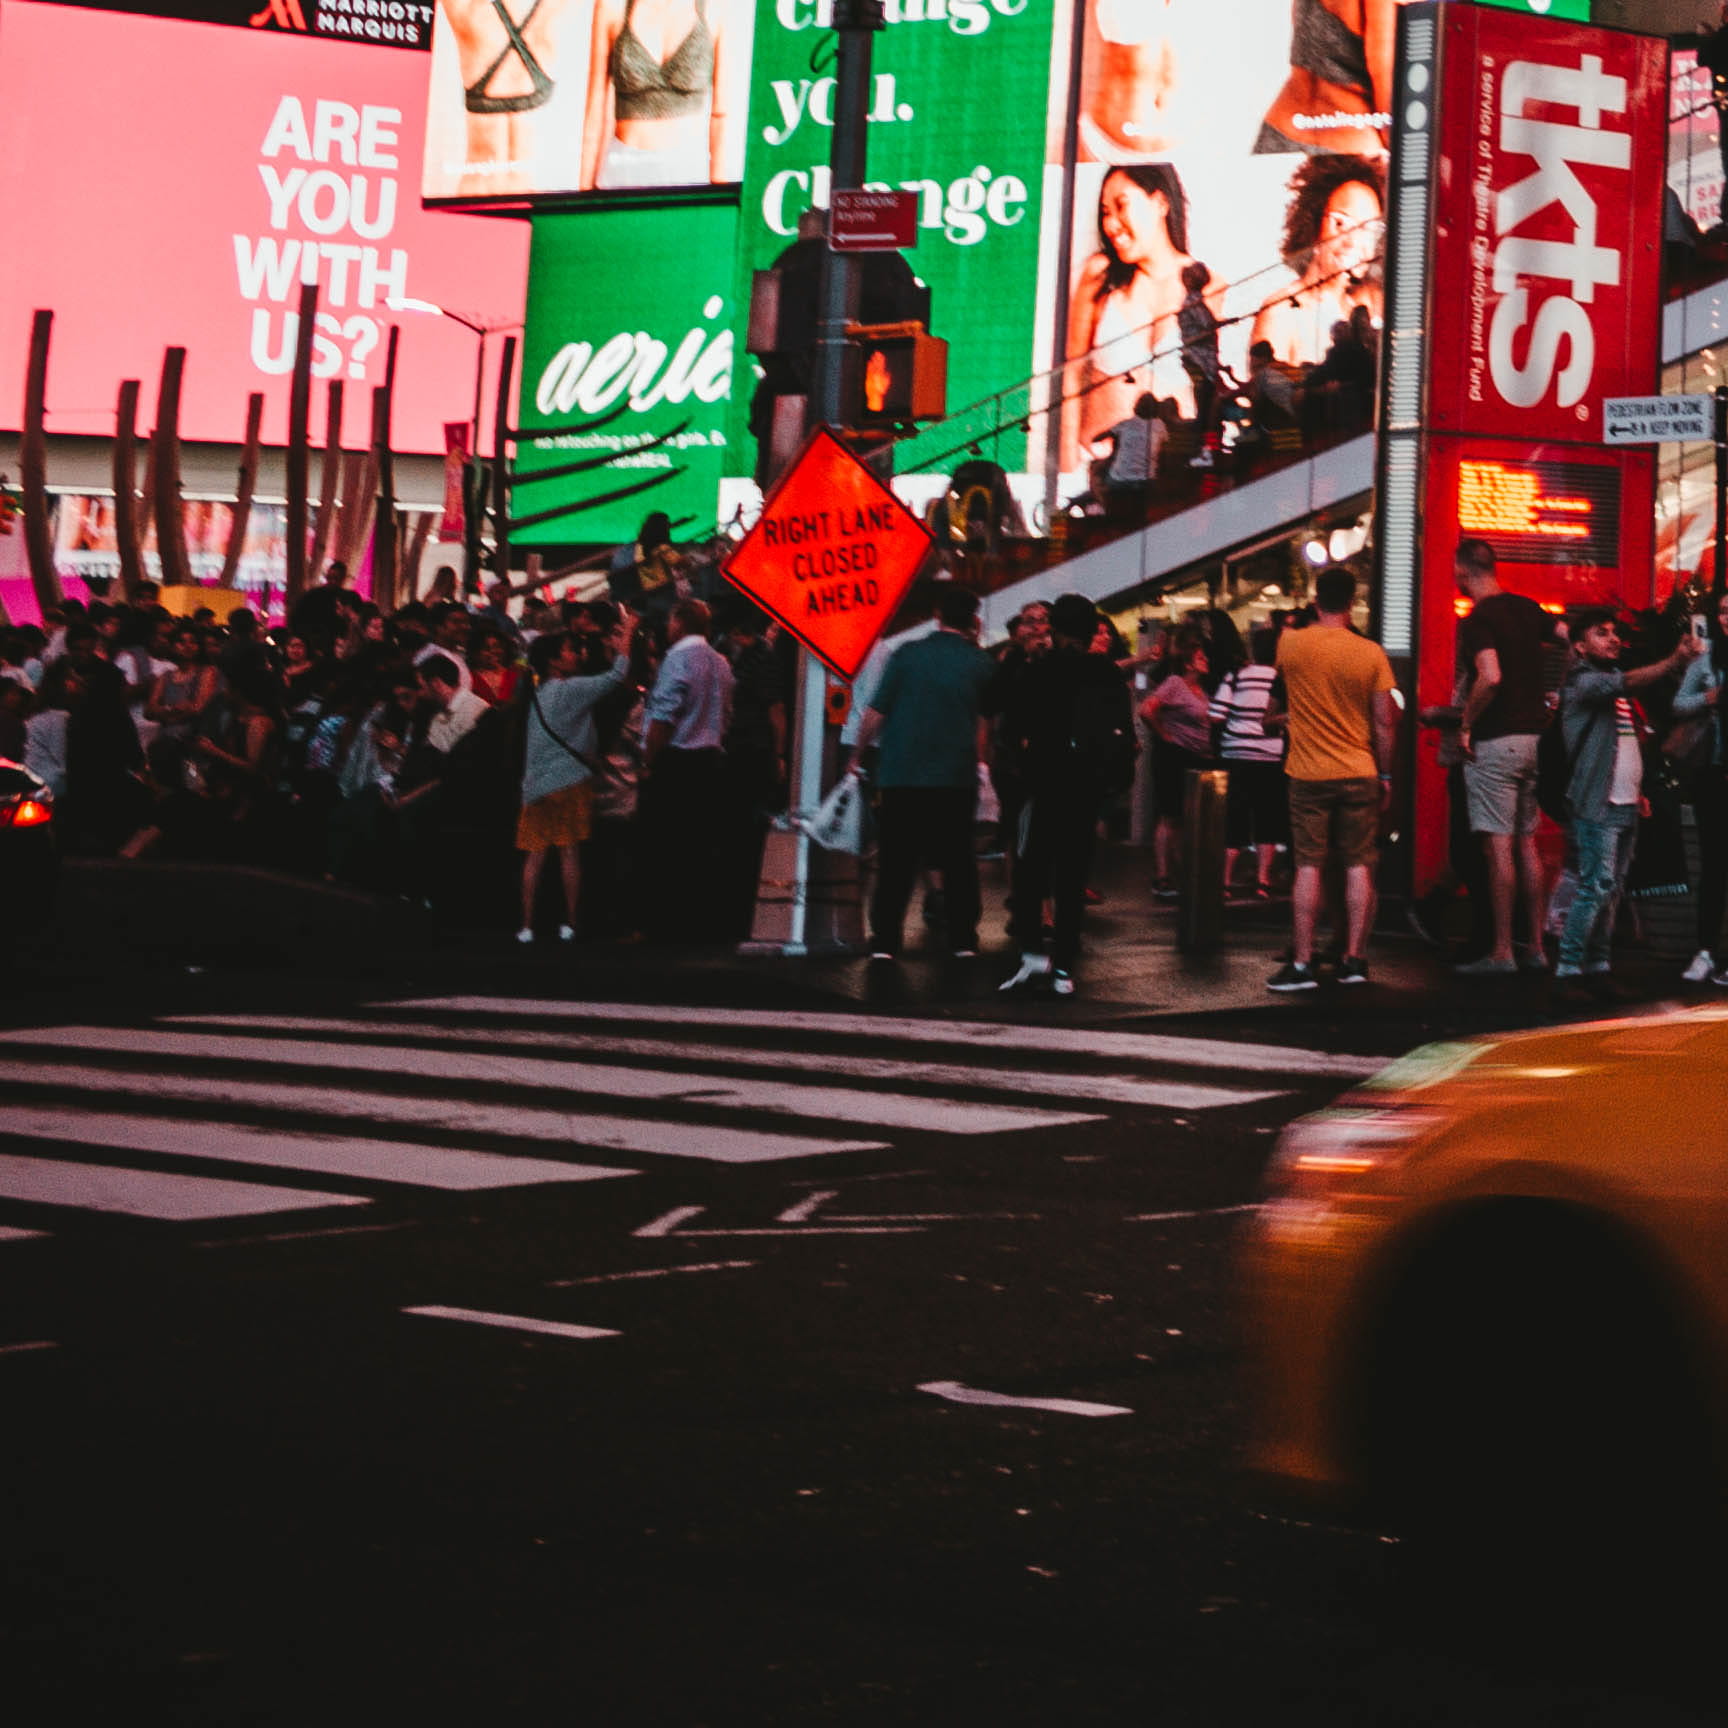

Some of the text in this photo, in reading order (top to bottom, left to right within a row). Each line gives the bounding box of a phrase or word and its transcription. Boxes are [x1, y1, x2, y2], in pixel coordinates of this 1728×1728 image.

[316, 13, 420, 44] MARQUIS
[260, 95, 402, 170] ARE
[257, 164, 398, 241] YOU
[1488, 53, 1632, 409] tkts
[233, 233, 408, 311] WITH
[763, 503, 896, 548] RIGHT LANE
[793, 542, 878, 583] CLOSED
[806, 578, 879, 619] AHEAD
